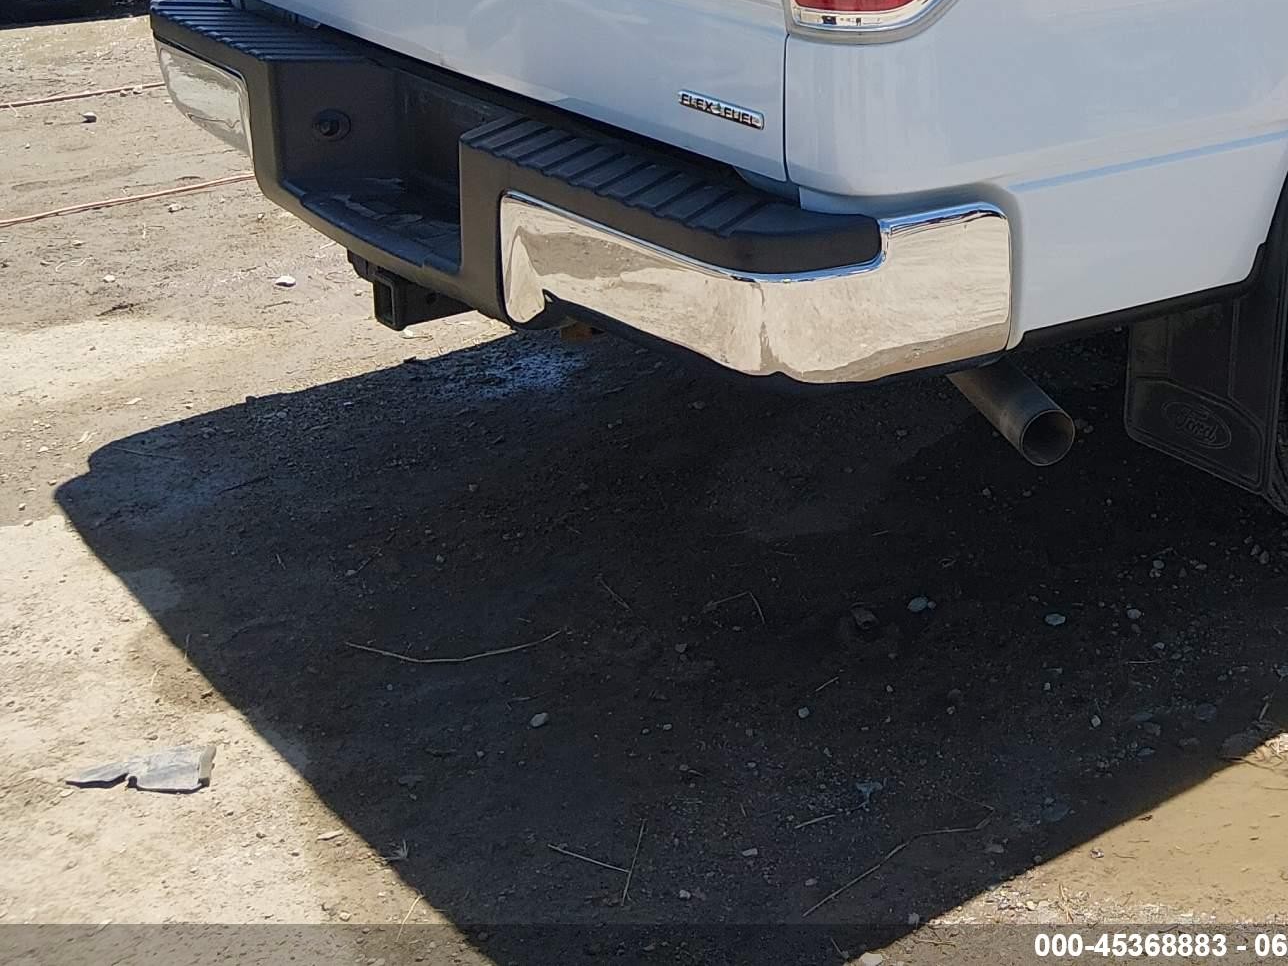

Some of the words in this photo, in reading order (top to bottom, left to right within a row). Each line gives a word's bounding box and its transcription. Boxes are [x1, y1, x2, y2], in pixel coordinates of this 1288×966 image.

[681, 92, 713, 112] FLEX
[723, 106, 761, 126] FUEL
[1175, 405, 1218, 443] Ford
